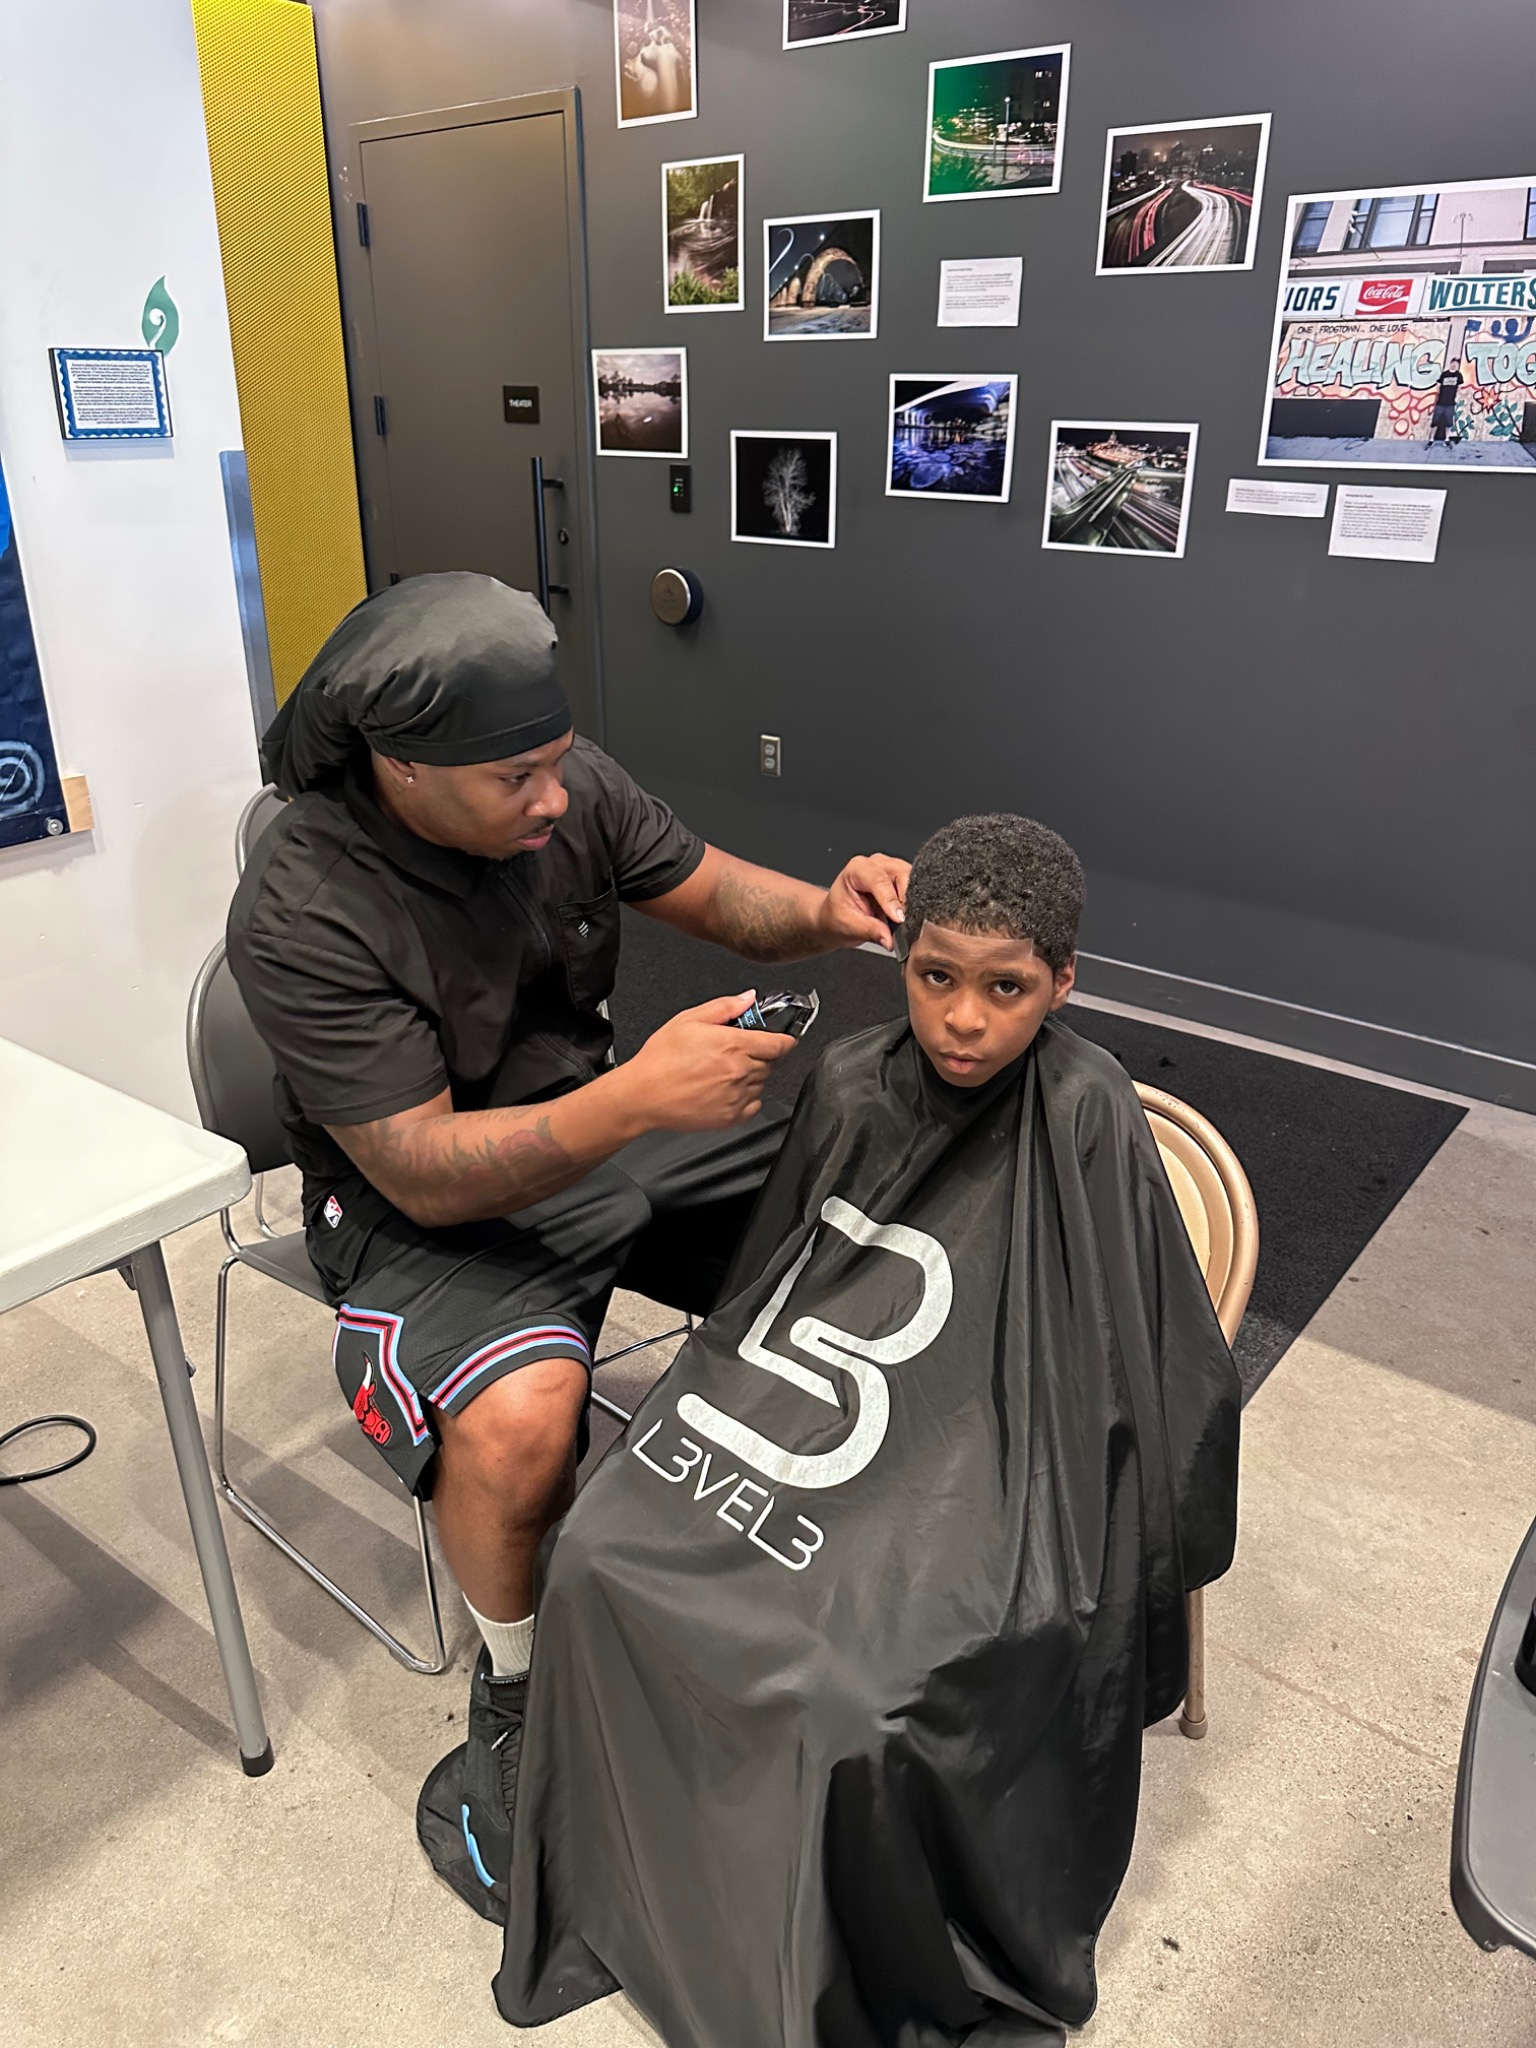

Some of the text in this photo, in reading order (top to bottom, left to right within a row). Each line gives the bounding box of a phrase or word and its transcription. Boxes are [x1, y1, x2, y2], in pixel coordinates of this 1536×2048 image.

[1429, 277, 1536, 311] WOLTERS
[1370, 324, 1386, 333] ONE
[1387, 323, 1408, 332] LOVE
[1276, 337, 1445, 390] HEALING
[509, 399, 532, 407] THEATER
